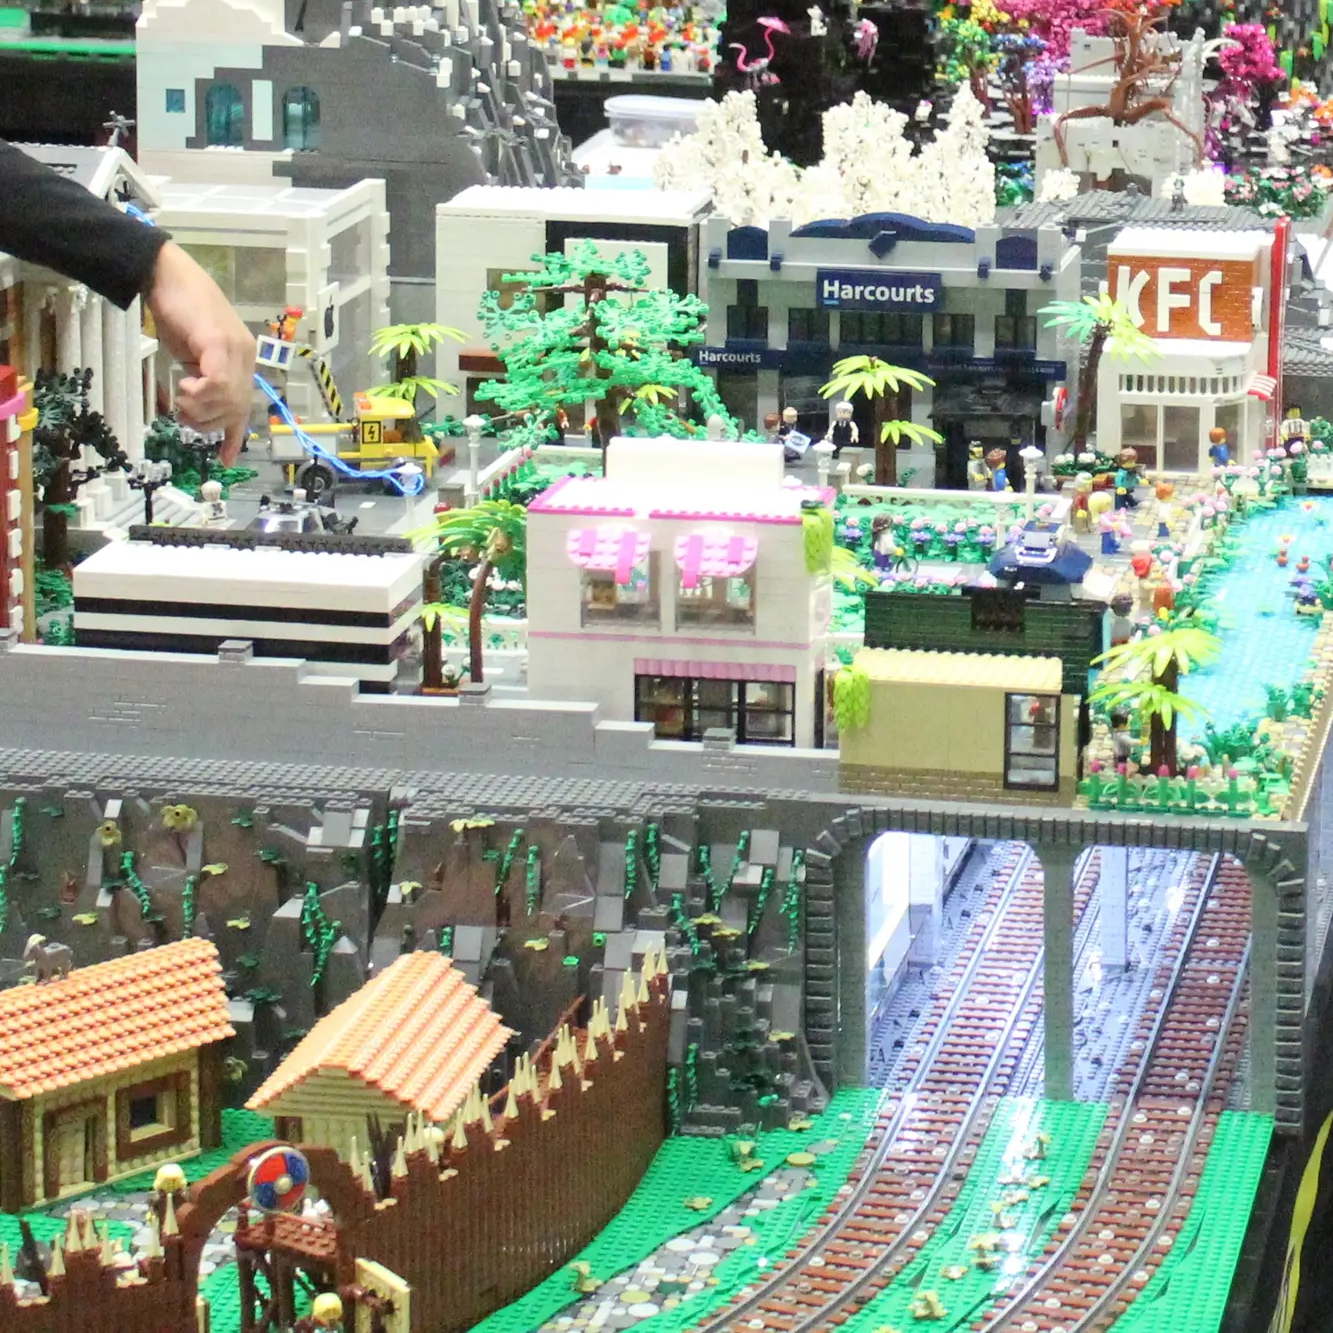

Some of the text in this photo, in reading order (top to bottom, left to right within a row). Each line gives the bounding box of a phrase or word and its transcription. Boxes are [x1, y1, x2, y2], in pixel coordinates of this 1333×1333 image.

[823, 279, 935, 304] Harcourts
[1115, 265, 1223, 336] KFC
[699, 350, 762, 364] Harcourts
